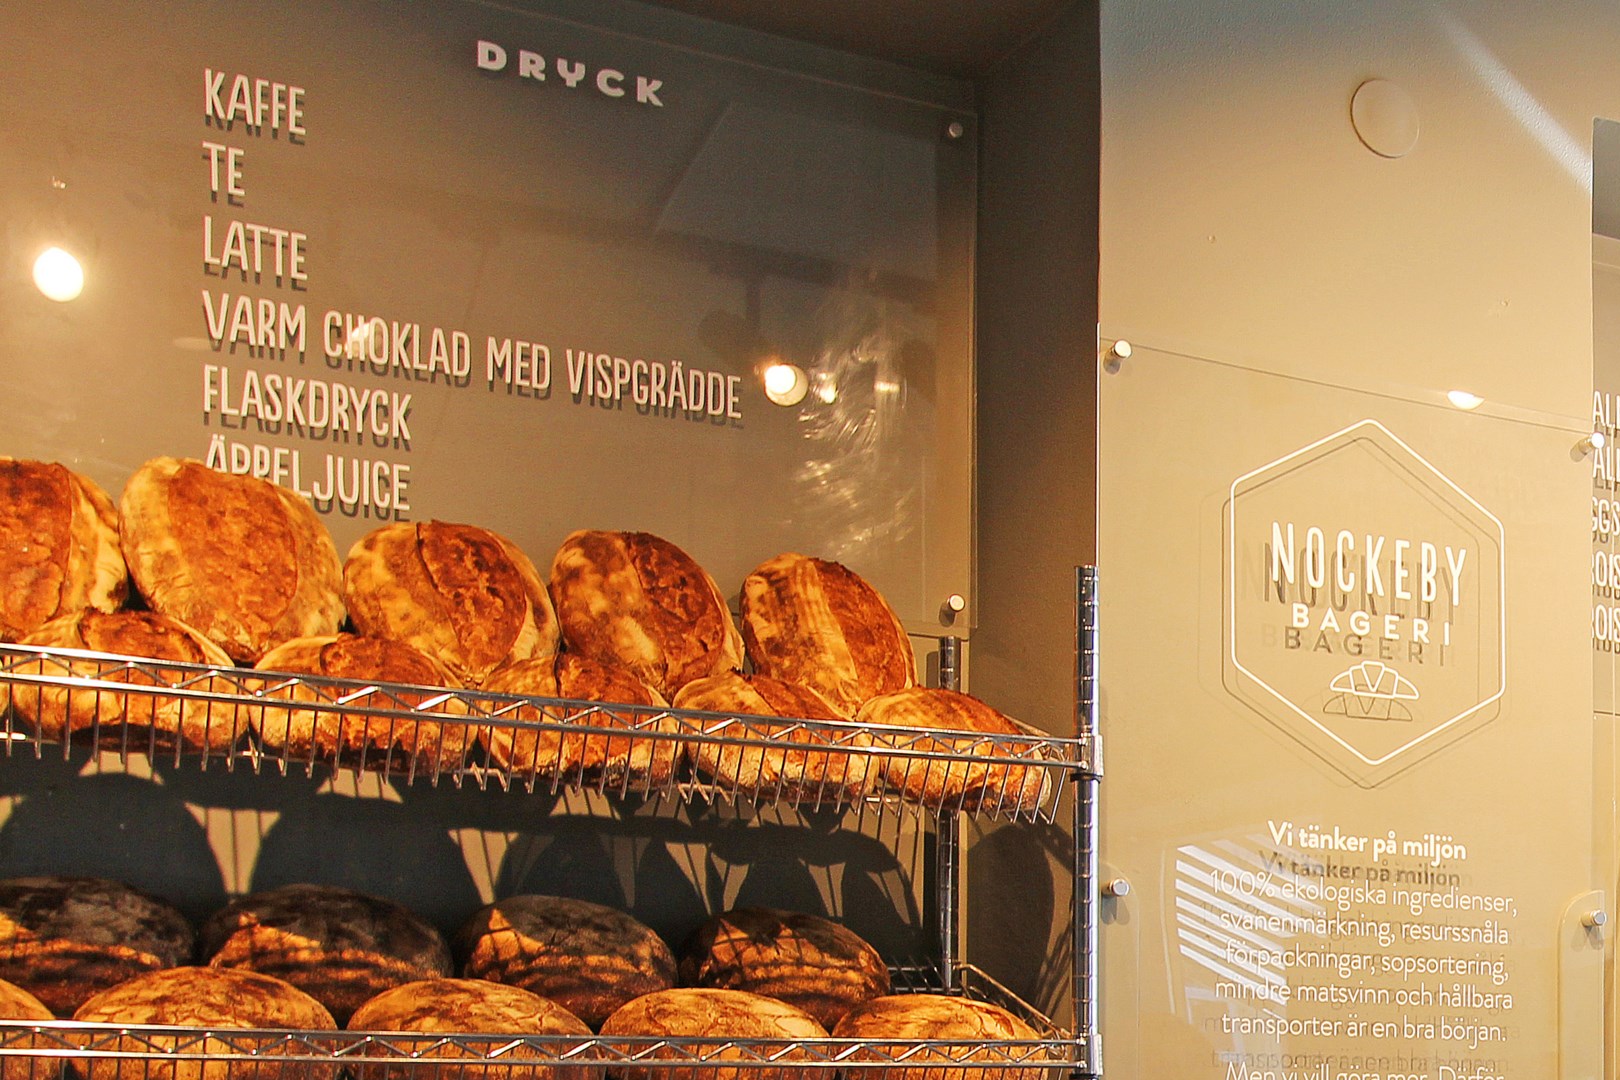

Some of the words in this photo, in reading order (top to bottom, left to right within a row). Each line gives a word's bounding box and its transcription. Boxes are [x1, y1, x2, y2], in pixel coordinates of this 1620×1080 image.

[476, 39, 663, 107] DRYCK
[204, 68, 306, 136] KAFFE
[203, 141, 245, 197] TE
[204, 215, 308, 281] LATTE
[203, 290, 306, 353] VARM
[324, 309, 471, 377] CHOKLAD
[487, 336, 551, 390] MED
[566, 348, 742, 419] VISPGRÄDDE
[203, 365, 412, 440] FLASKDRYCK
[1271, 520, 1467, 608] NOCKEBY
[1292, 602, 1450, 647] BAGERI
[1267, 820, 1294, 847] Vi
[1299, 825, 1368, 853] tänker
[1373, 831, 1396, 863] på
[1402, 834, 1467, 867] miljön
[1210, 868, 1275, 899] 100%
[1281, 876, 1386, 911] ekologiska
[1392, 882, 1519, 918] ingredienser,
[1219, 911, 1397, 947] svanenmärkning,
[1402, 915, 1509, 945] resurssnåla
[1225, 940, 1376, 979] förpackningar,
[1382, 951, 1510, 985] sopsortering,
[1215, 974, 1291, 1001] mindre
[1297, 984, 1390, 1005] matsvinn
[1396, 981, 1433, 1007] och
[1439, 983, 1513, 1010] hållbara
[1222, 1013, 1343, 1043] transporter
[1346, 1018, 1370, 1038] är
[1372, 1021, 1397, 1038] en
[1403, 1016, 1436, 1040] bra
[1440, 1017, 1507, 1050] början.
